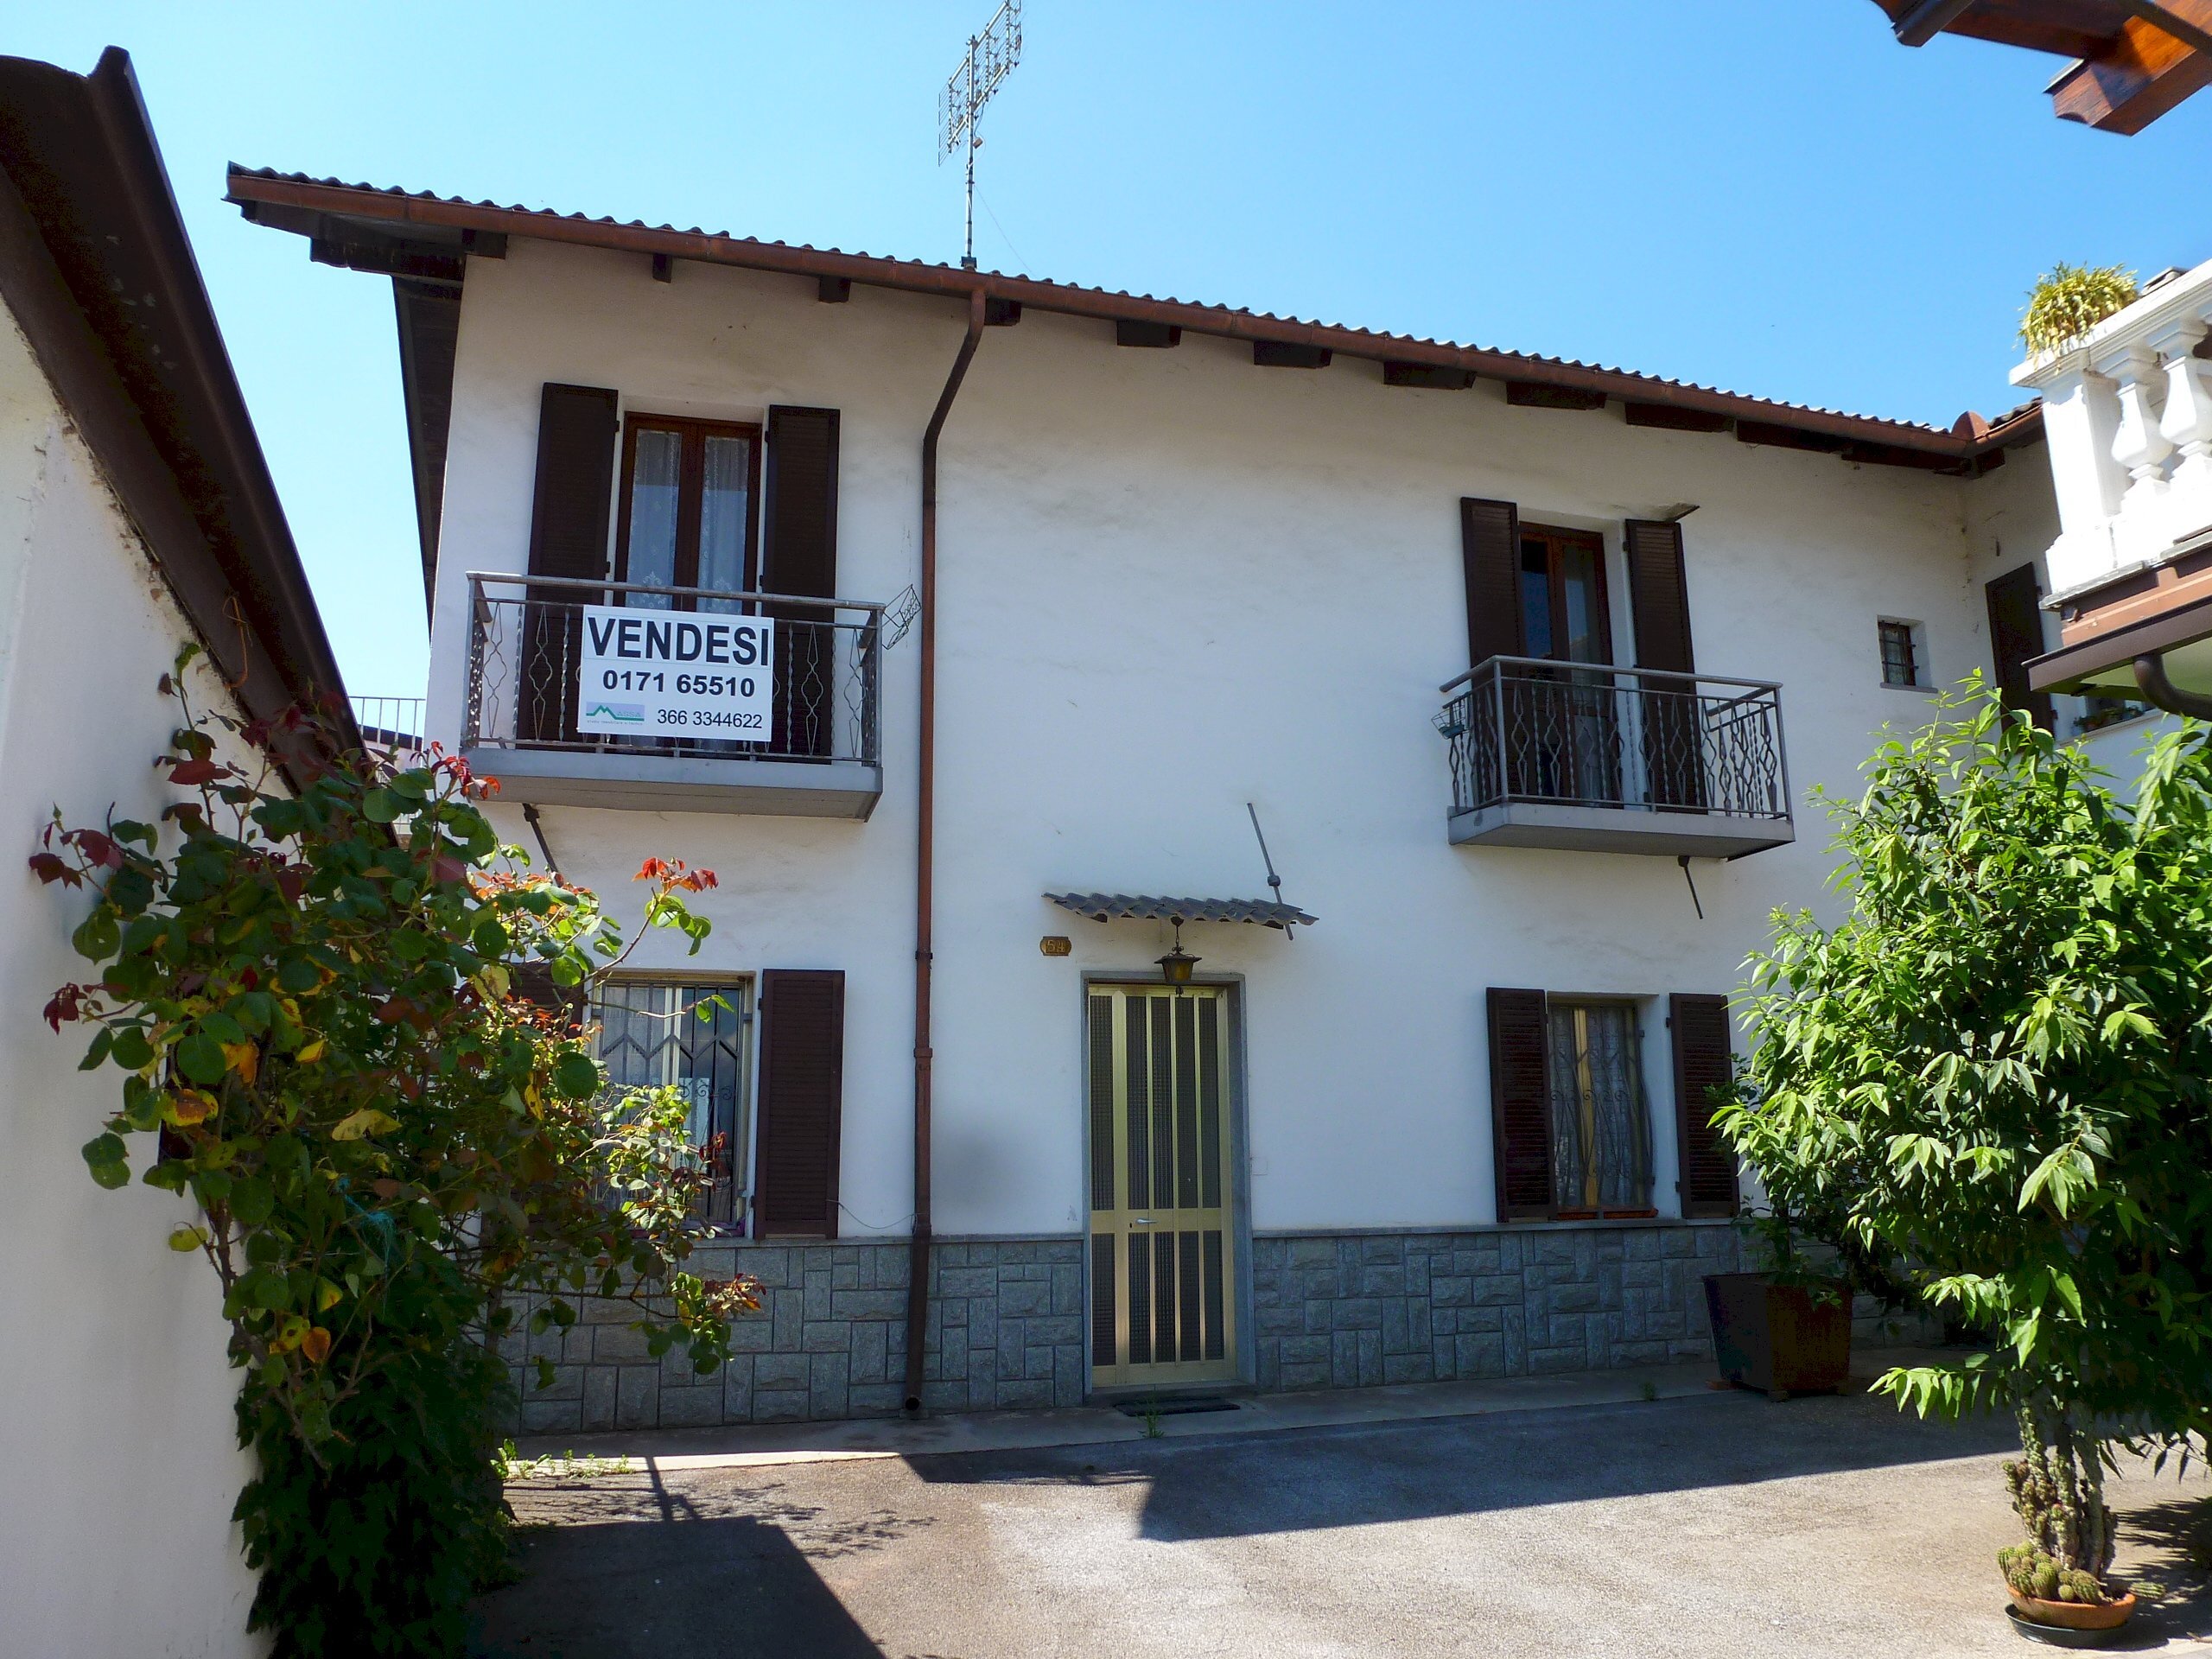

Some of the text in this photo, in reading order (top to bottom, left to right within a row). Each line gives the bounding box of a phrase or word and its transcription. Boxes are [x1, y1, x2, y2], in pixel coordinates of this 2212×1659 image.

[588, 617, 769, 666] VENDESI
[602, 670, 755, 697] 0171 65510
[657, 709, 763, 729] 366 3344622
